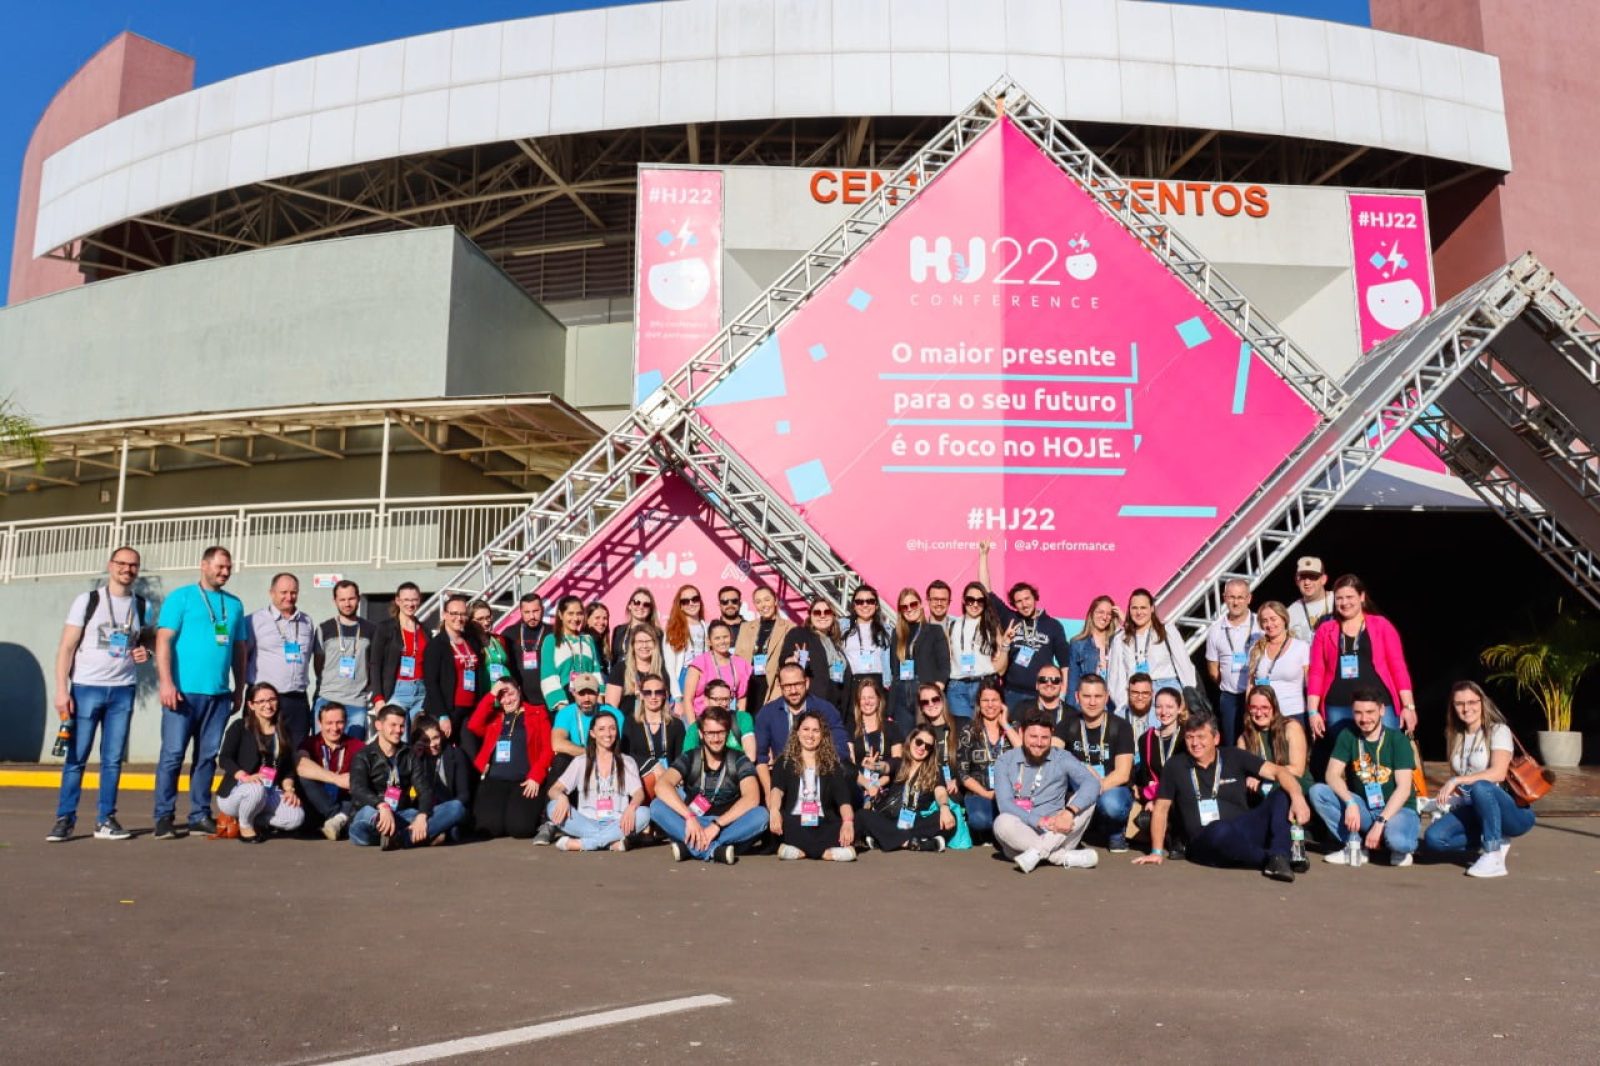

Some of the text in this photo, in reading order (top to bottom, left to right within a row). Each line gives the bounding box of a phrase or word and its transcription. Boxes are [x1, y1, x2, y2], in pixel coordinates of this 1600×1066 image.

[648, 187, 713, 206] #HJ22
[1357, 211, 1418, 230] #HJ22
[910, 293, 1100, 310] CONFERENCE
[891, 342, 1117, 369] O maior presente
[894, 388, 1117, 414] para o seu futuro
[891, 433, 1121, 459] é o foco no HOJE.
[967, 506, 1056, 532] #HJ22
[1014, 539, 1116, 554] @a9.performance
